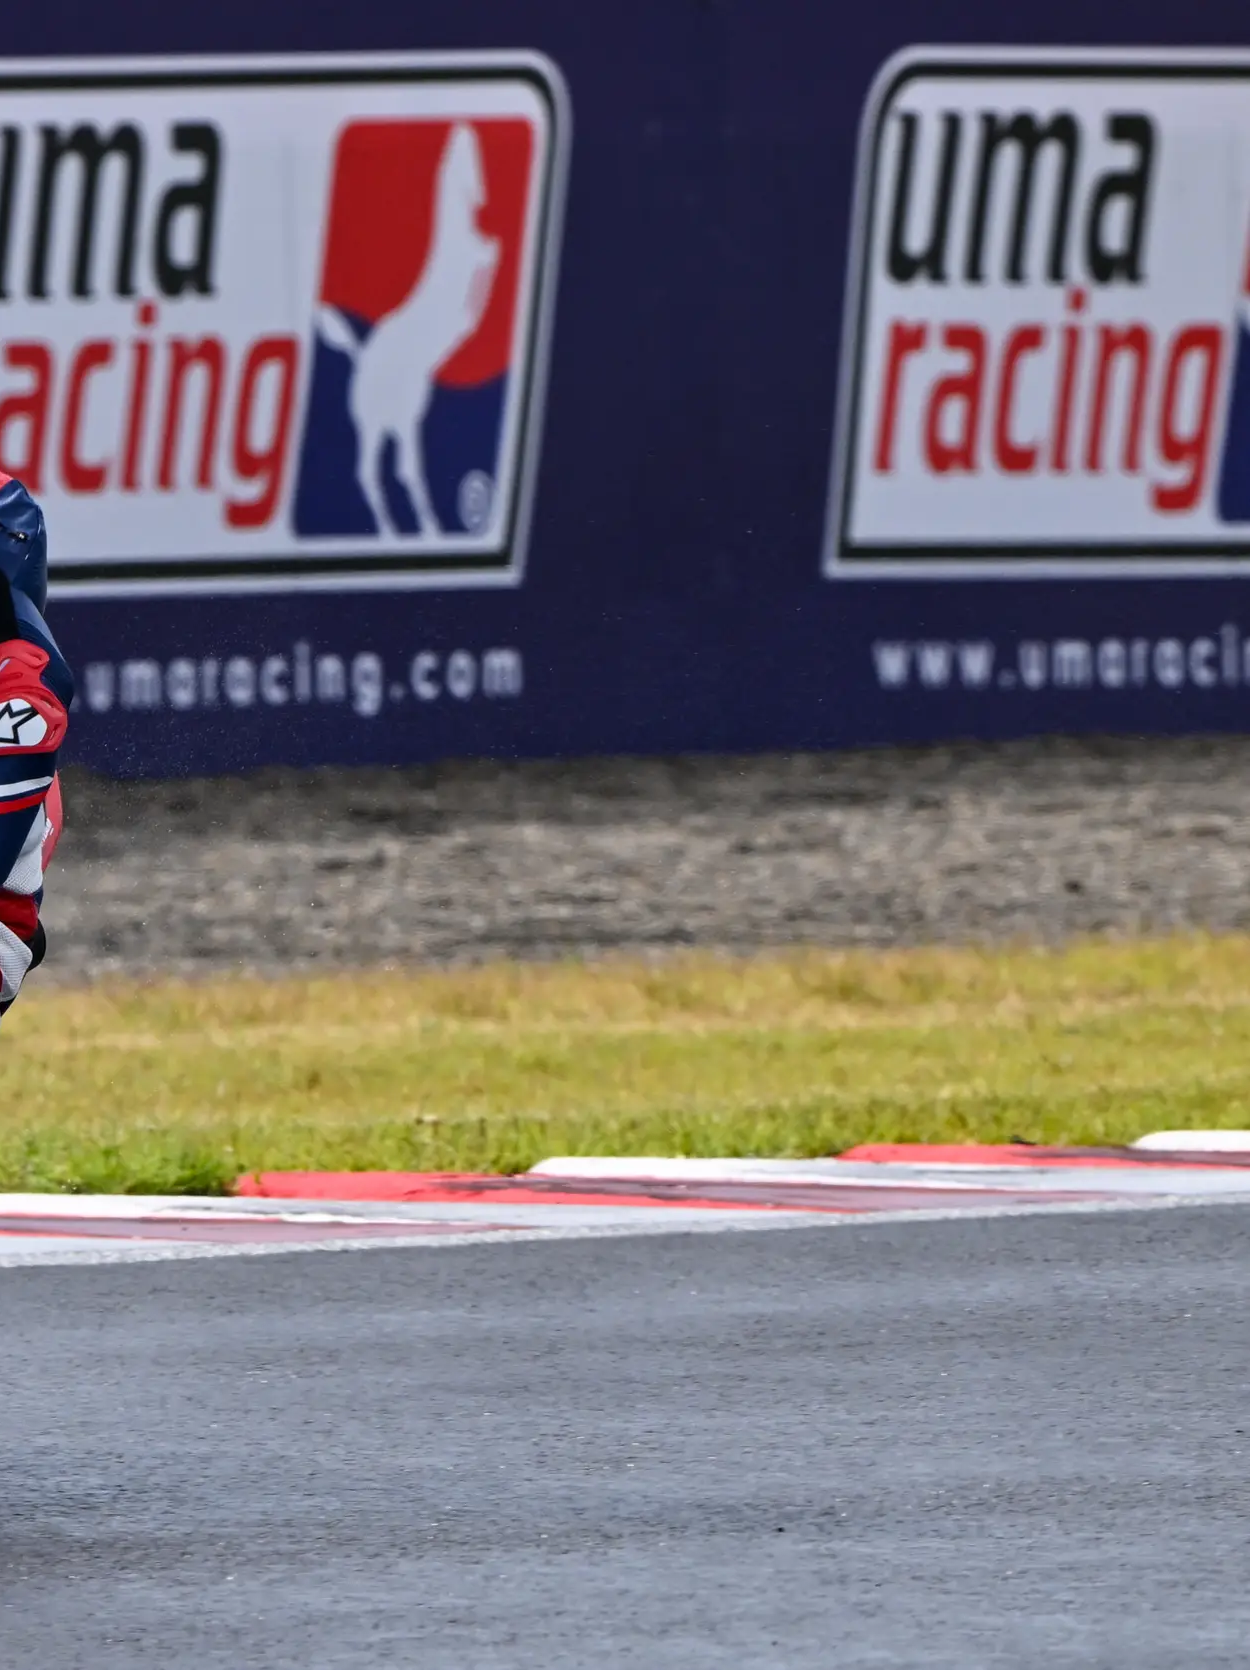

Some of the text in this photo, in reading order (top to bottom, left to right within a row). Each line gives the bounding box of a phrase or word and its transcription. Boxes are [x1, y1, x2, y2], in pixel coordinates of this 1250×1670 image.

[885, 110, 1159, 286] uma
[873, 290, 1224, 515] racing
[871, 622, 1250, 692] www.umaraci
